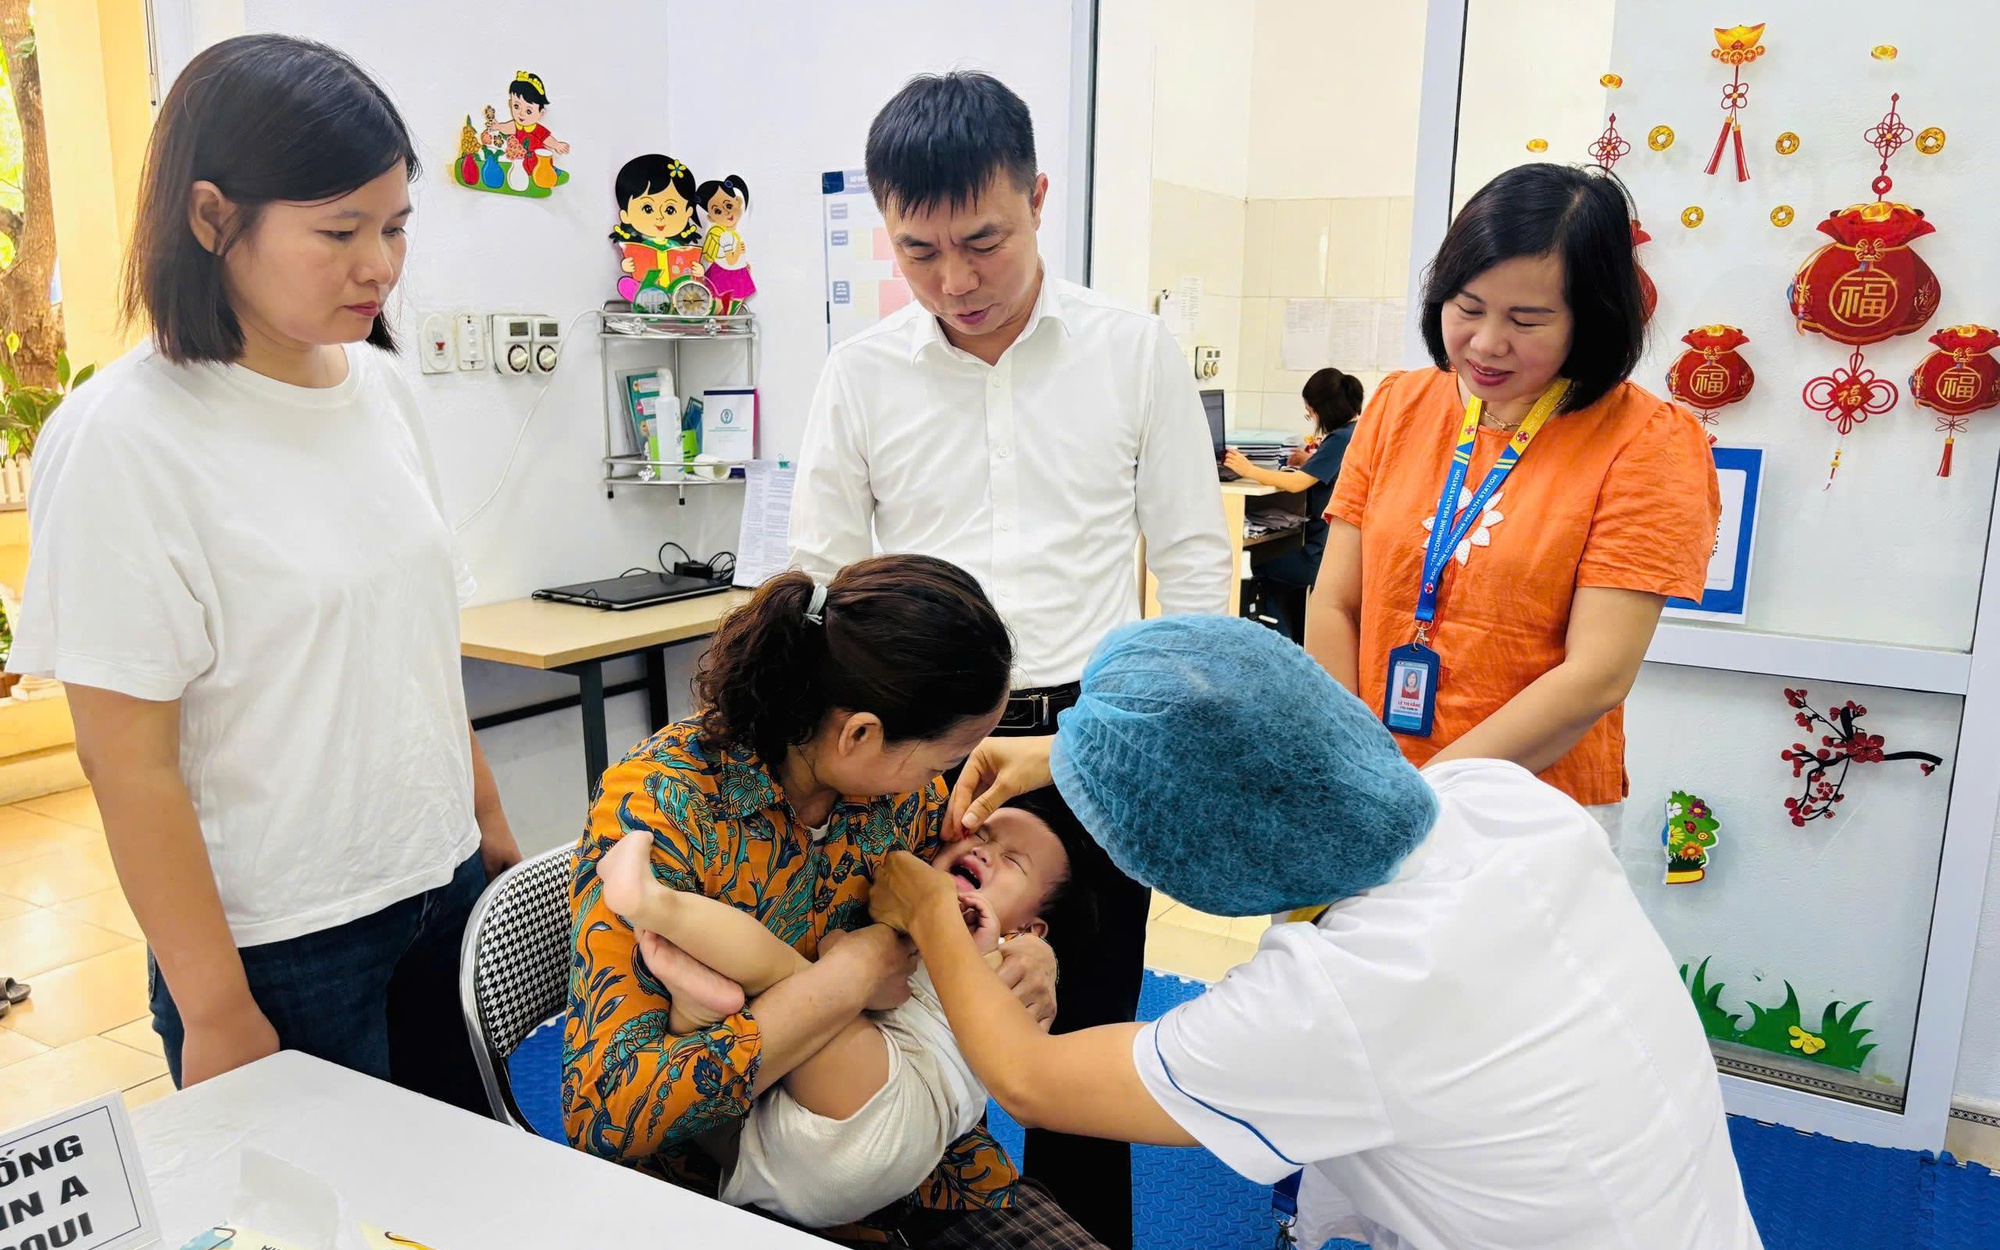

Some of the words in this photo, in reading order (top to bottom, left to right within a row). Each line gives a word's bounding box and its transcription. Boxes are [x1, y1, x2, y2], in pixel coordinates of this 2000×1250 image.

[1837, 277, 1891, 318] 福
[1695, 368, 1725, 393] 福
[1942, 371, 1976, 398] 福
[1434, 519, 1448, 552] COMMUNE
[1443, 494, 1454, 518] HEALTH
[1450, 469, 1462, 497] STATION
[1445, 522, 1466, 554] COMMUNE
[1465, 499, 1481, 523] HEALTH
[1479, 474, 1499, 501] STATION
[60, 1175, 90, 1205] A
